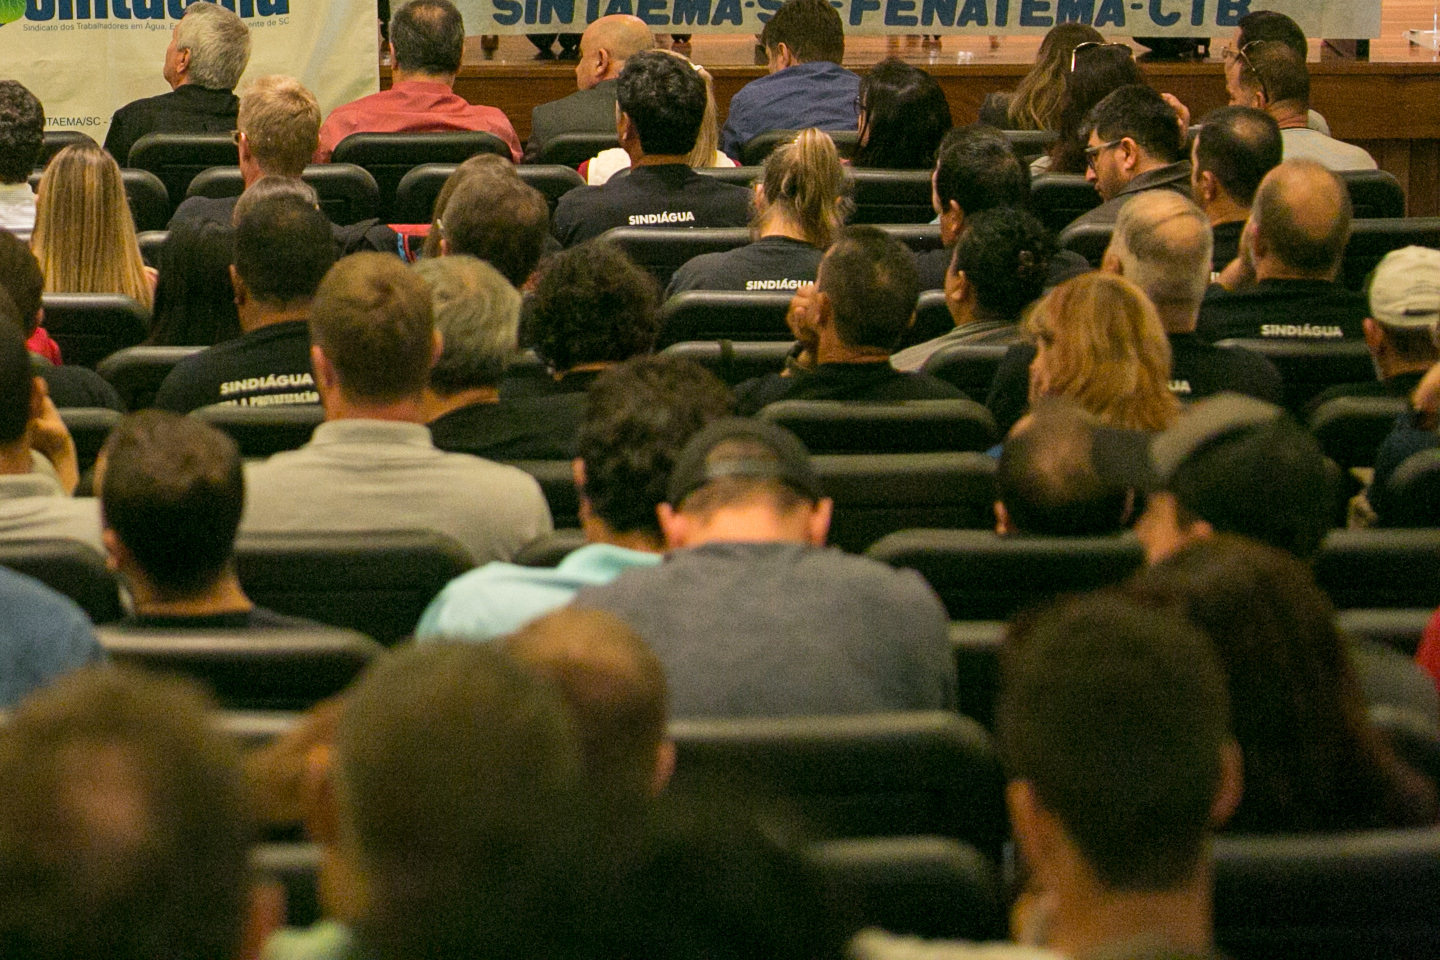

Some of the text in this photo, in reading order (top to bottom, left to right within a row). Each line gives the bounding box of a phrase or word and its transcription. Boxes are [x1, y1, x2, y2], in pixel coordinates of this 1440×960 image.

[23, 23, 58, 32] Sindicato
[60, 23, 75, 31] dos
[76, 22, 129, 30] Trabalhadores
[266, 19, 277, 27] de
[278, 16, 290, 25] SC
[46, 116, 101, 126] TAEMA/SC
[628, 211, 696, 226] SINDIÁGUA
[1261, 323, 1343, 337] SINDIÁGUA
[220, 372, 315, 395] SINDIÁGUA
